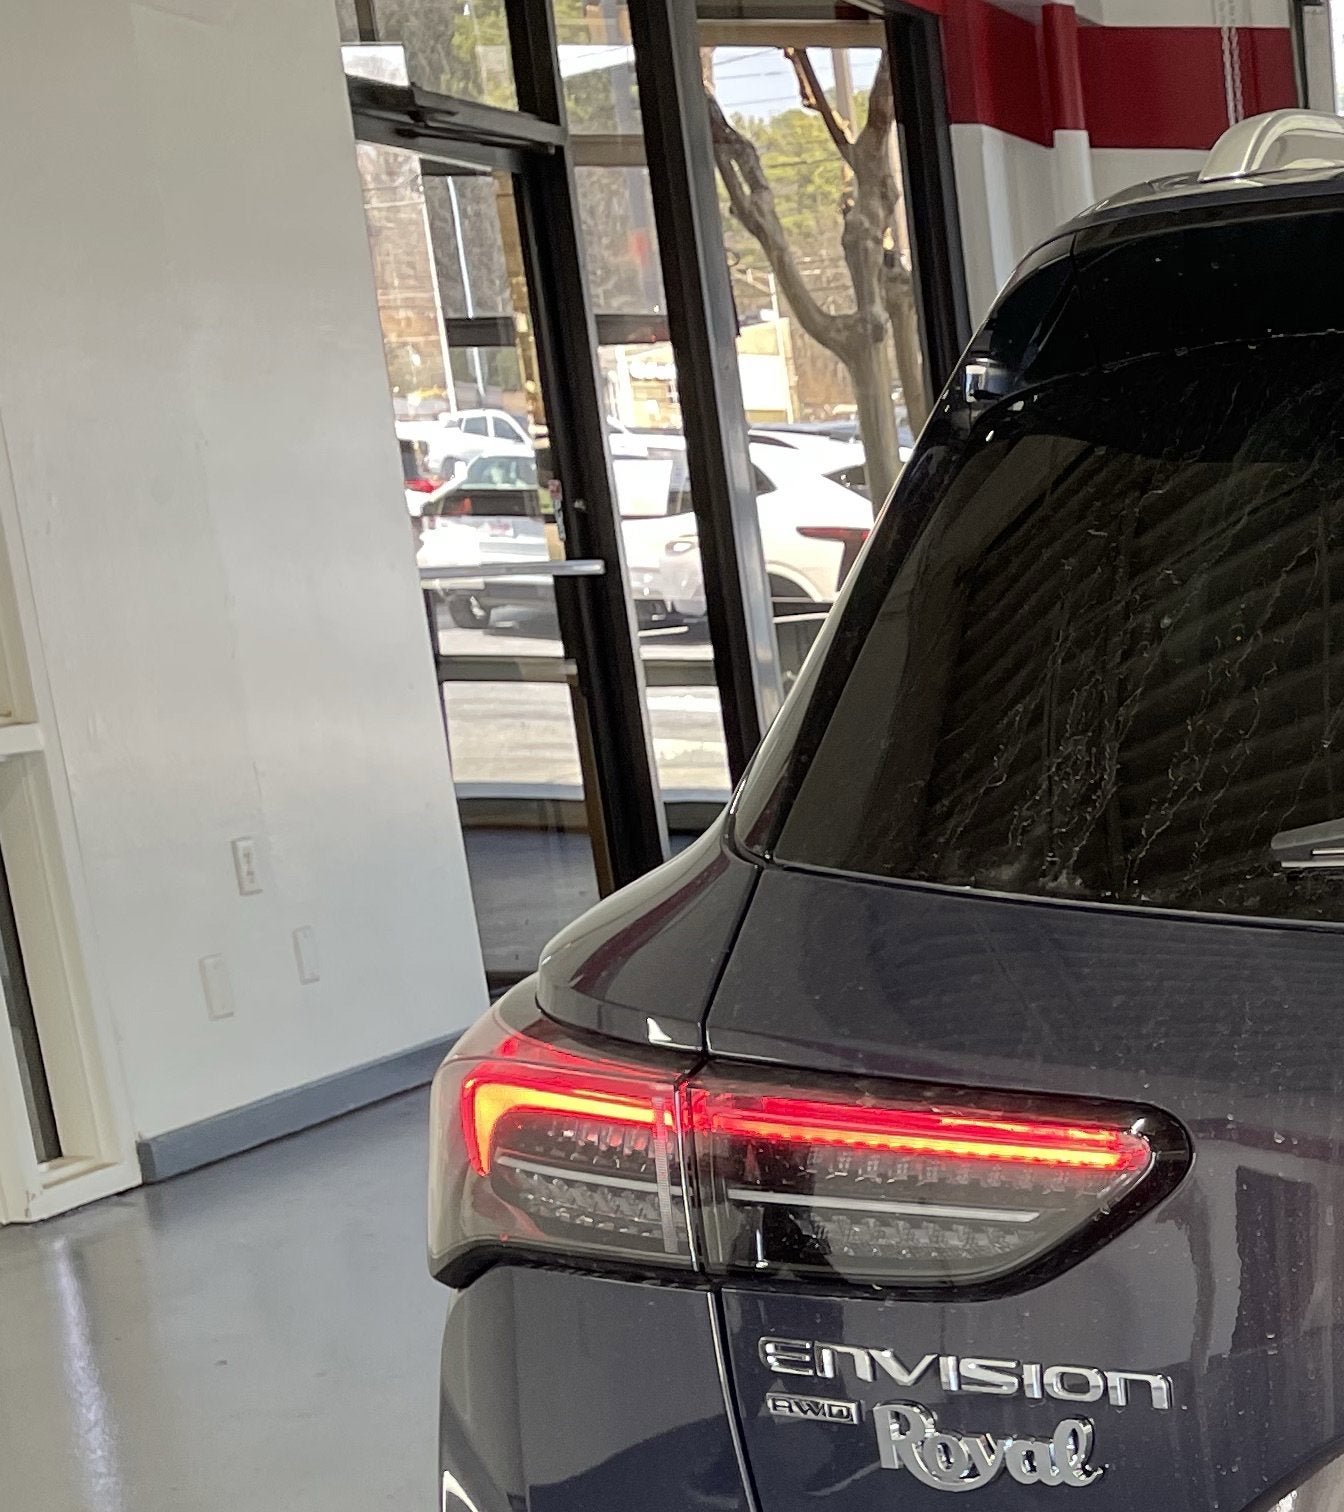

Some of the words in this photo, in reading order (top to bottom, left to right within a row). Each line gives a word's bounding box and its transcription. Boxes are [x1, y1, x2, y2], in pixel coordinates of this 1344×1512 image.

[758, 1335, 1173, 1410] ENVISION
[771, 1396, 854, 1422] AWD
[872, 1397, 1109, 1492] Royal
